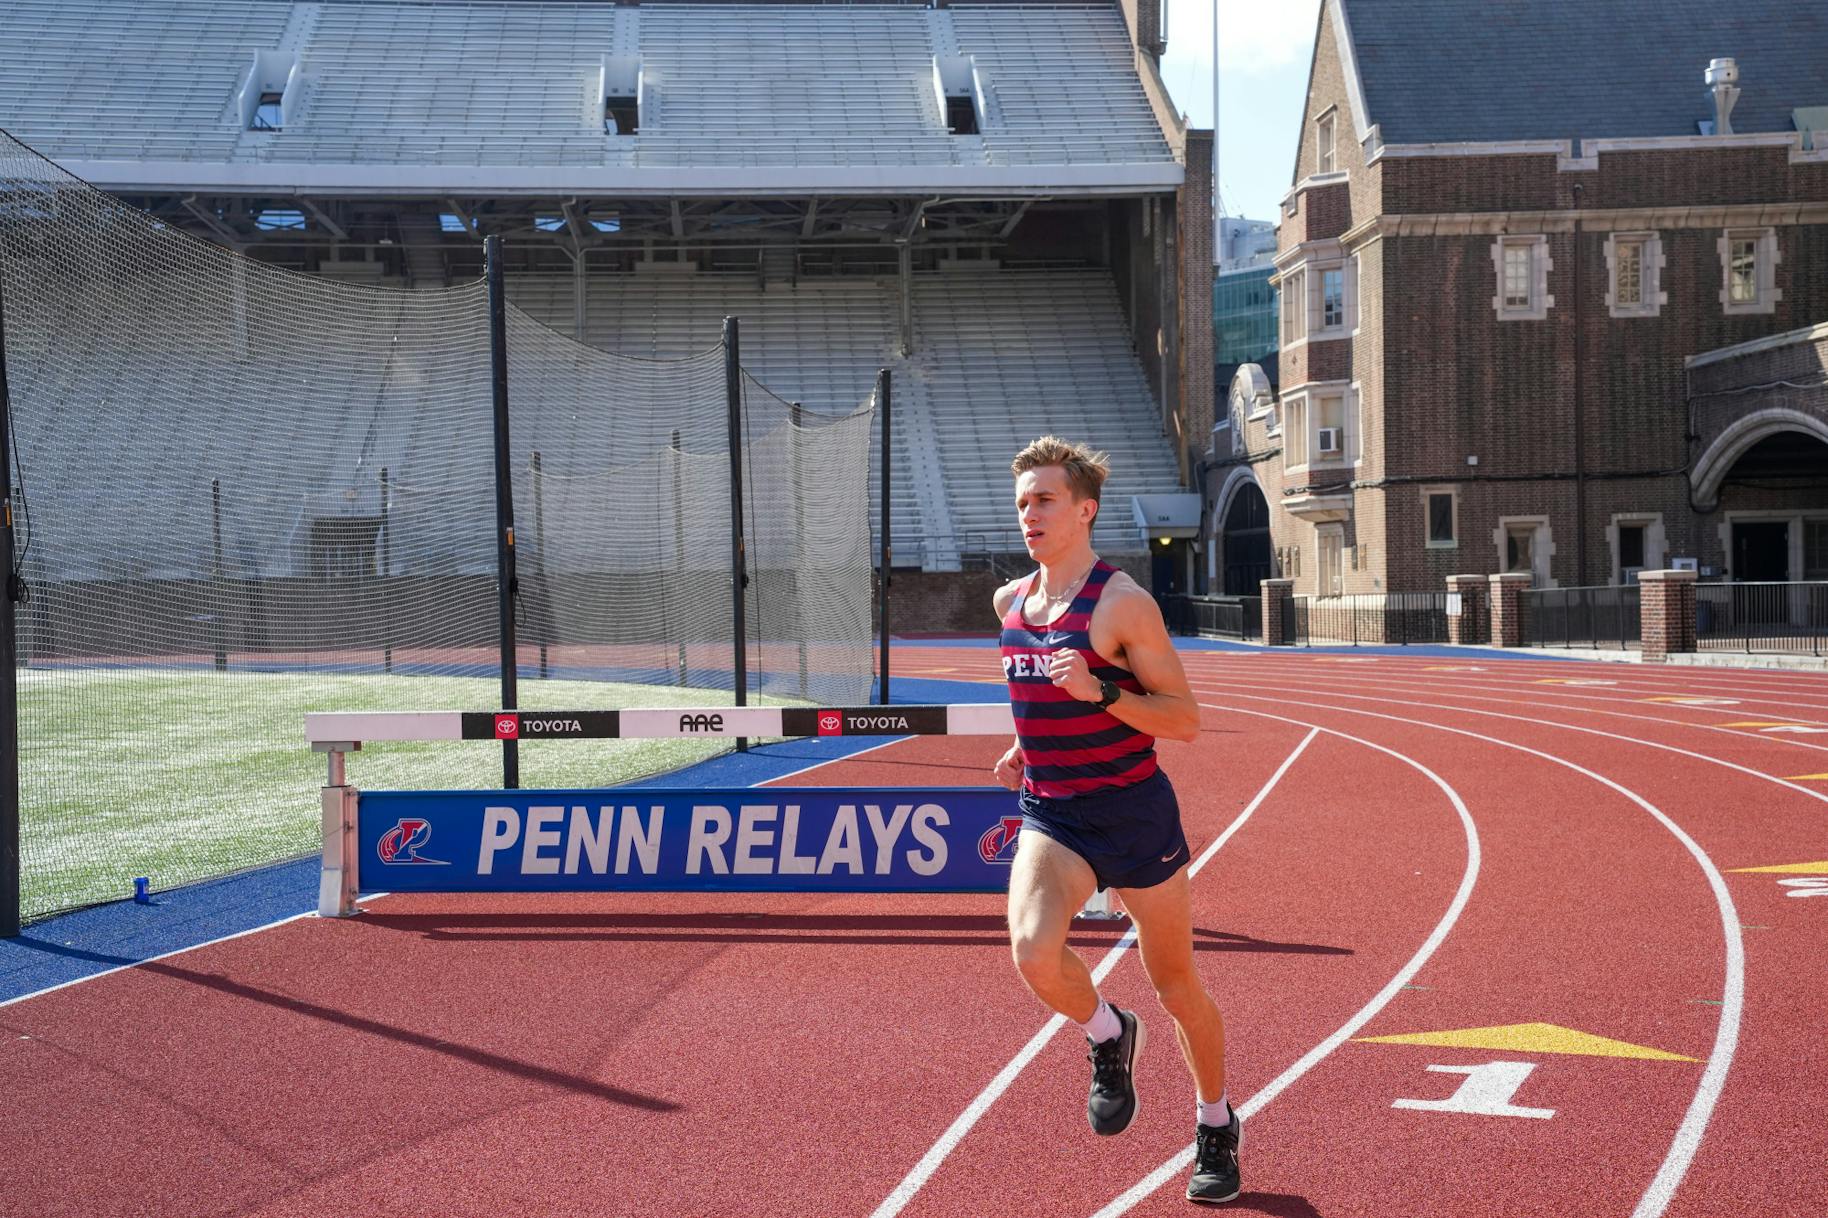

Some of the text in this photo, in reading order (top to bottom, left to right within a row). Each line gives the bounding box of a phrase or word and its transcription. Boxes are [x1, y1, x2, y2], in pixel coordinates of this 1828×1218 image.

[523, 720, 582, 732] TOYOTA
[847, 717, 909, 729] TOYOTA
[477, 806, 665, 875] PENN
[685, 804, 950, 876] RELAYS
[1391, 1061, 1556, 1119] 1
